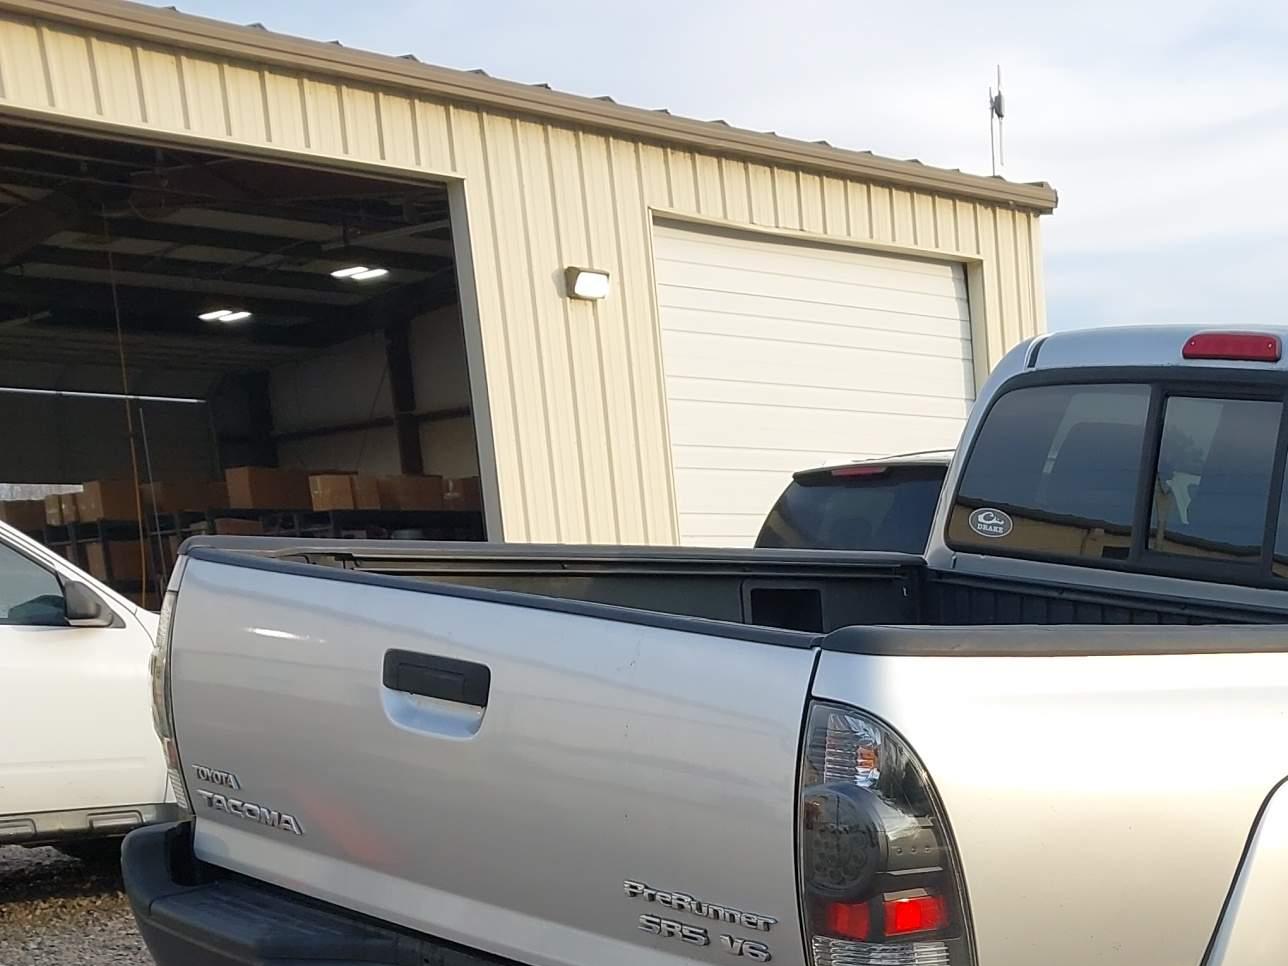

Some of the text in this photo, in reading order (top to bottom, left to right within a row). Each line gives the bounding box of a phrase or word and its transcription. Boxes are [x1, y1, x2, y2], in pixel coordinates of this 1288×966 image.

[977, 523, 1004, 533] DRAKE
[192, 764, 241, 790] TOYOTA
[197, 789, 304, 835] TACOMA
[623, 879, 778, 931] PreRunner
[638, 914, 772, 962] SR5 V6
